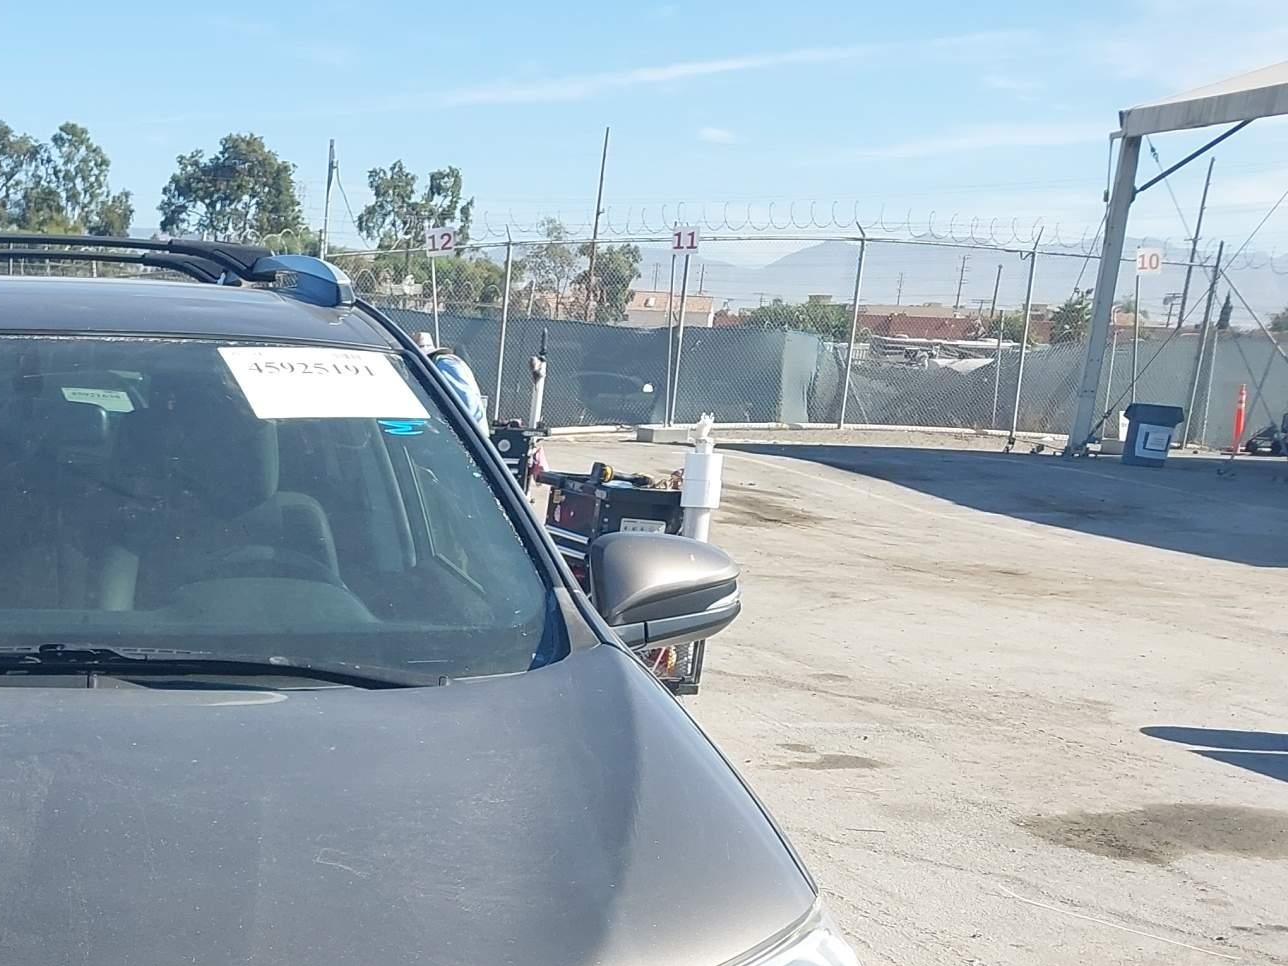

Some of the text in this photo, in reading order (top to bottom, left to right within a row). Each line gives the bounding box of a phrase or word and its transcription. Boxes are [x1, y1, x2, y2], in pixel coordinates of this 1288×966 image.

[428, 232, 453, 251] 12
[673, 231, 697, 249] 11
[1138, 253, 1160, 270] 10
[248, 361, 375, 377] 45925191
